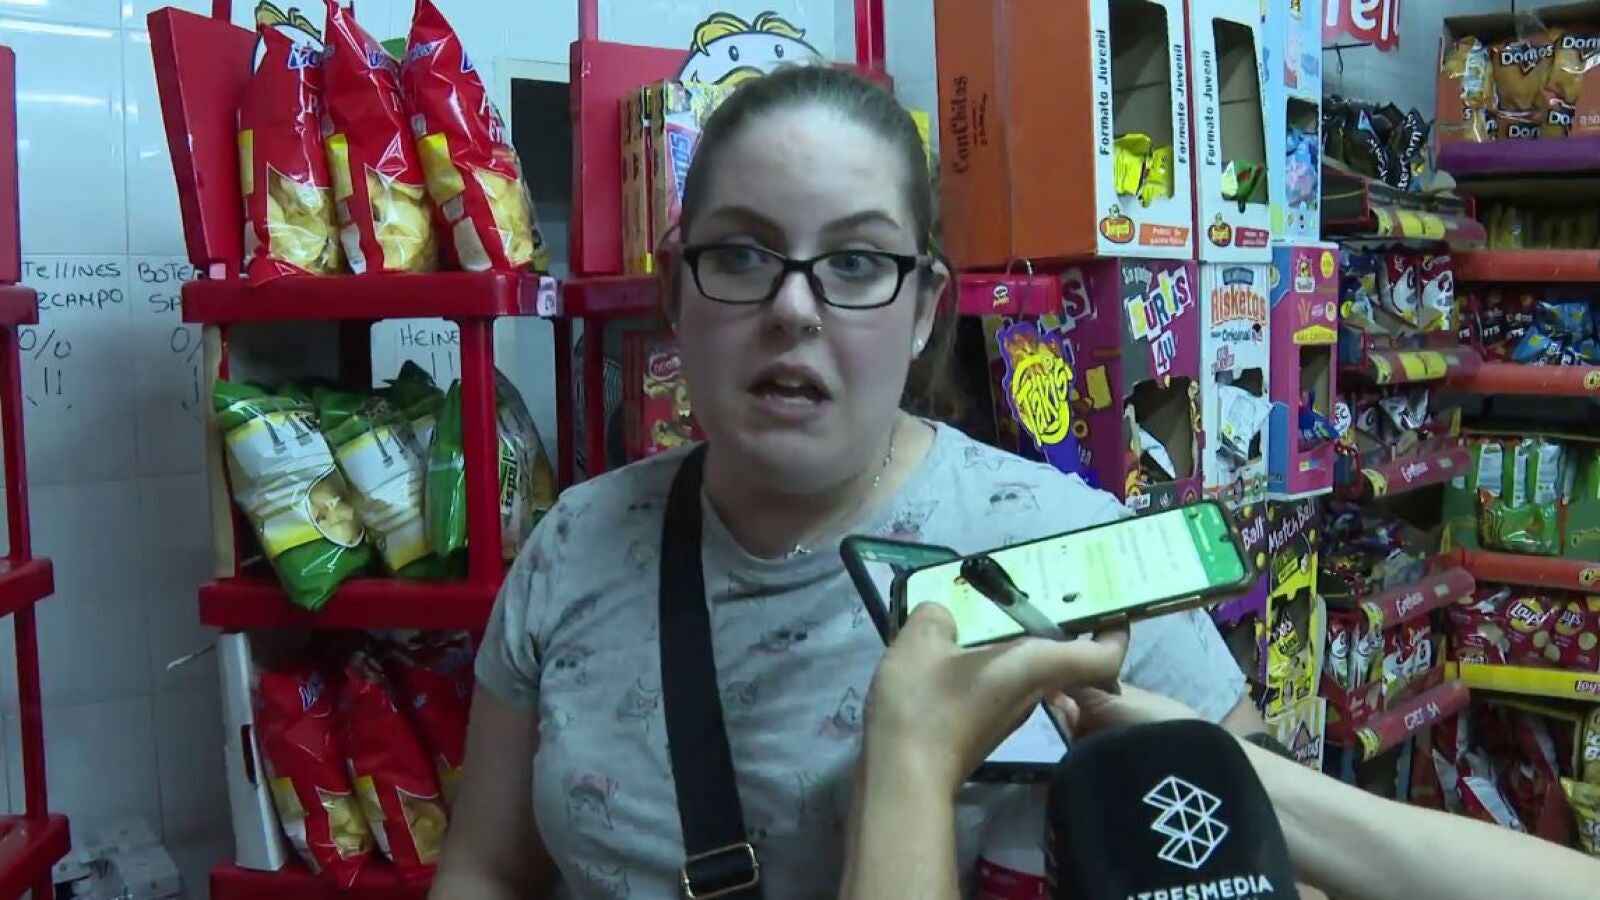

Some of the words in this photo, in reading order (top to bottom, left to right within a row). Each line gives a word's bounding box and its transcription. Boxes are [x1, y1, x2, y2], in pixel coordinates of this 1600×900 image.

[1095, 29, 1108, 85] Juvenil
[1173, 44, 1184, 97] Juvenil
[1201, 50, 1213, 102] Juvenil
[1099, 91, 1111, 155] Formato
[1176, 102, 1187, 164] Formato
[1204, 107, 1216, 166] Formato
[1241, 515, 1265, 551] Ball
[1267, 517, 1300, 554] Match
[1295, 501, 1317, 528] Ball
